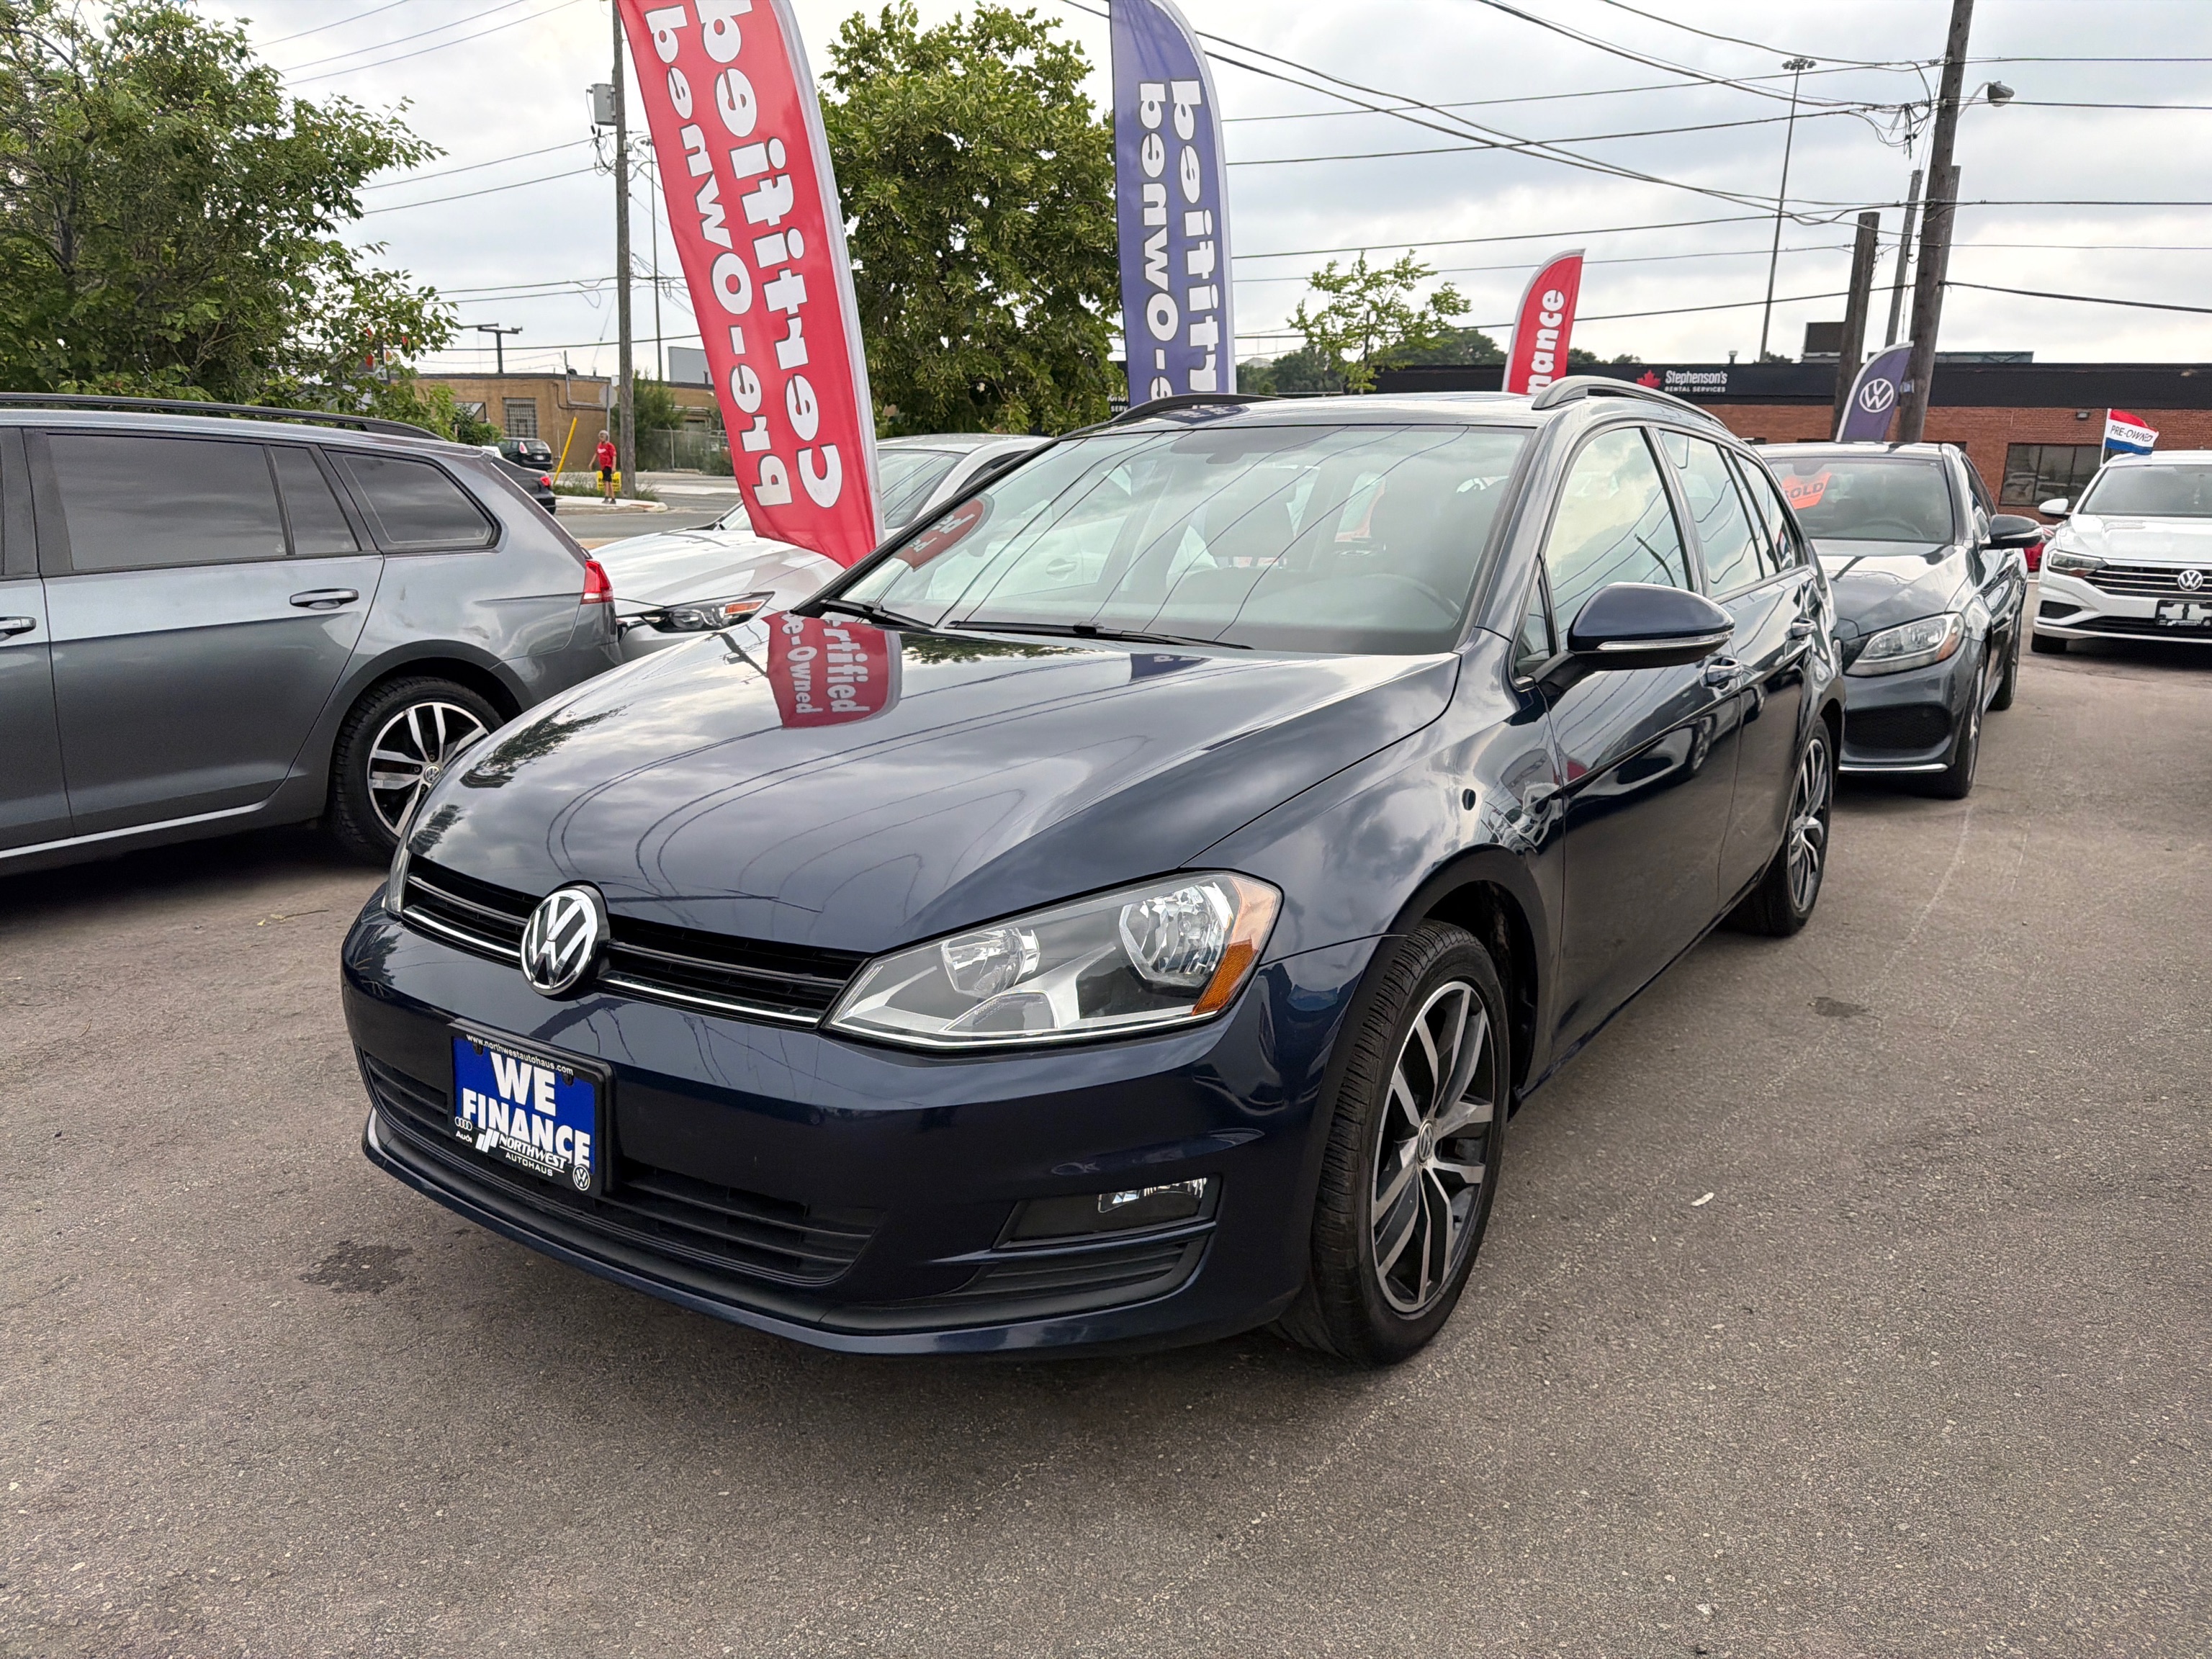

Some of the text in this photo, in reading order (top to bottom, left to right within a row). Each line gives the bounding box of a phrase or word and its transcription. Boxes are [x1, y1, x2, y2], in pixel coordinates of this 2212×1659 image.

[1665, 370, 1728, 385] Stephenson's
[2110, 425, 2154, 442] PRE-OWNED
[467, 1034, 573, 1075] www.northwestautohaus.com
[490, 1051, 556, 1116] WE
[462, 1088, 590, 1168] FINANCE
[499, 1135, 569, 1169] NORTHWEST
[505, 1153, 553, 1177] AUTOHAUS
